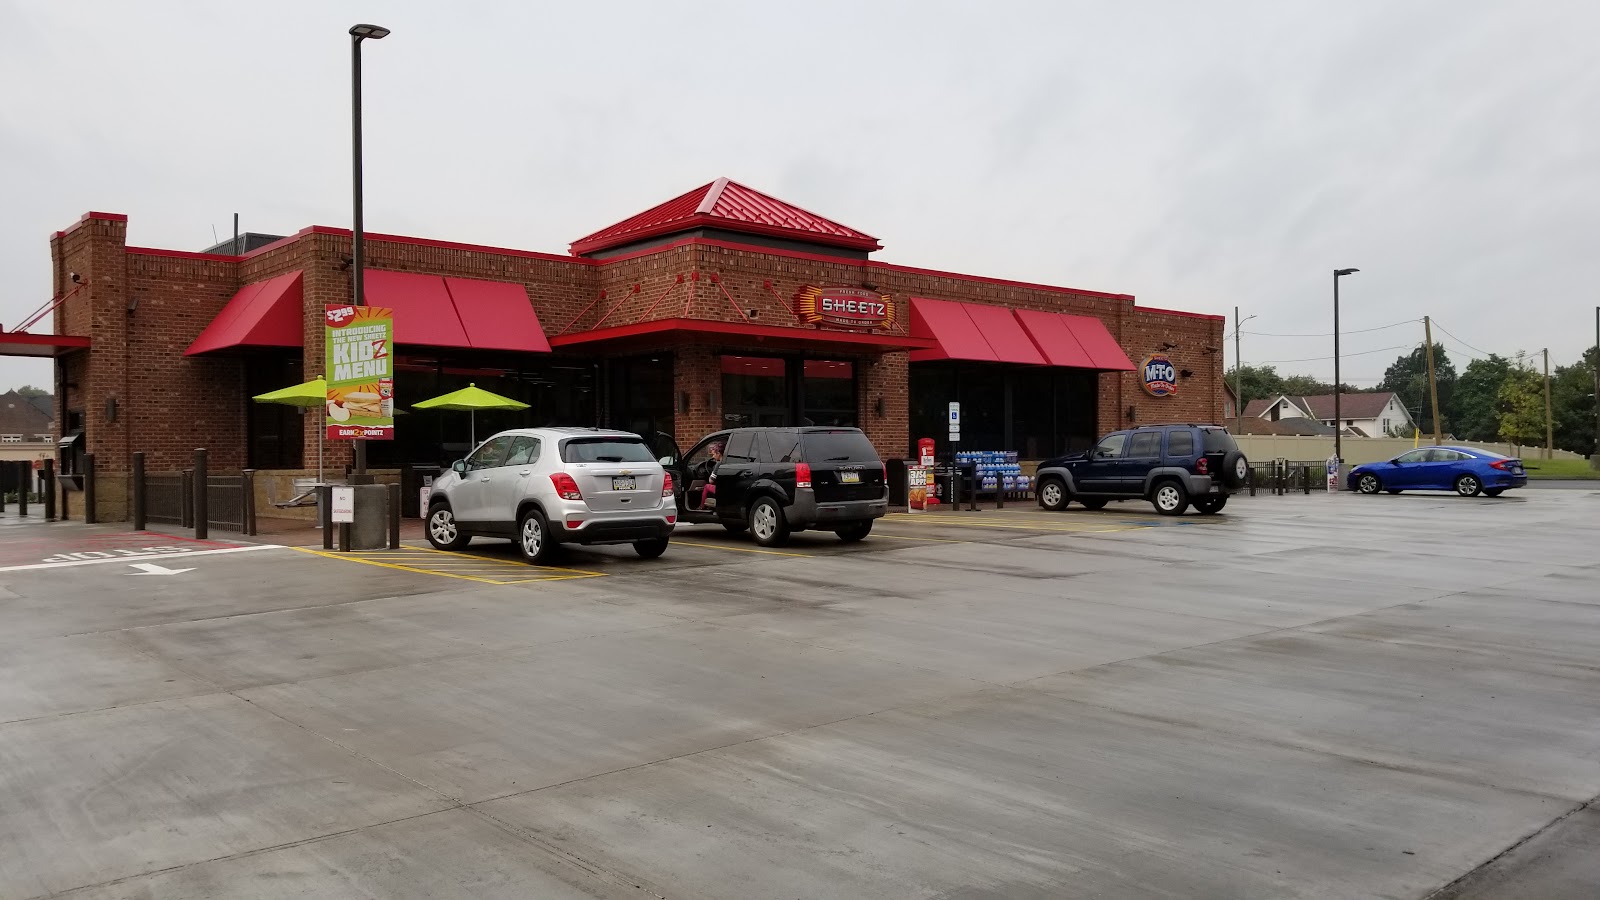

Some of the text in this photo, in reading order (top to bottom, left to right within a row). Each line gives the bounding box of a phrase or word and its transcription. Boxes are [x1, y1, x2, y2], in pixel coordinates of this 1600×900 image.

[822, 298, 885, 316] SHEETZ
[332, 325, 386, 337] INTRODUCING
[333, 332, 386, 344] THE NEW SHEETZ
[333, 358, 387, 382] MENU
[42, 546, 192, 563] STOP
